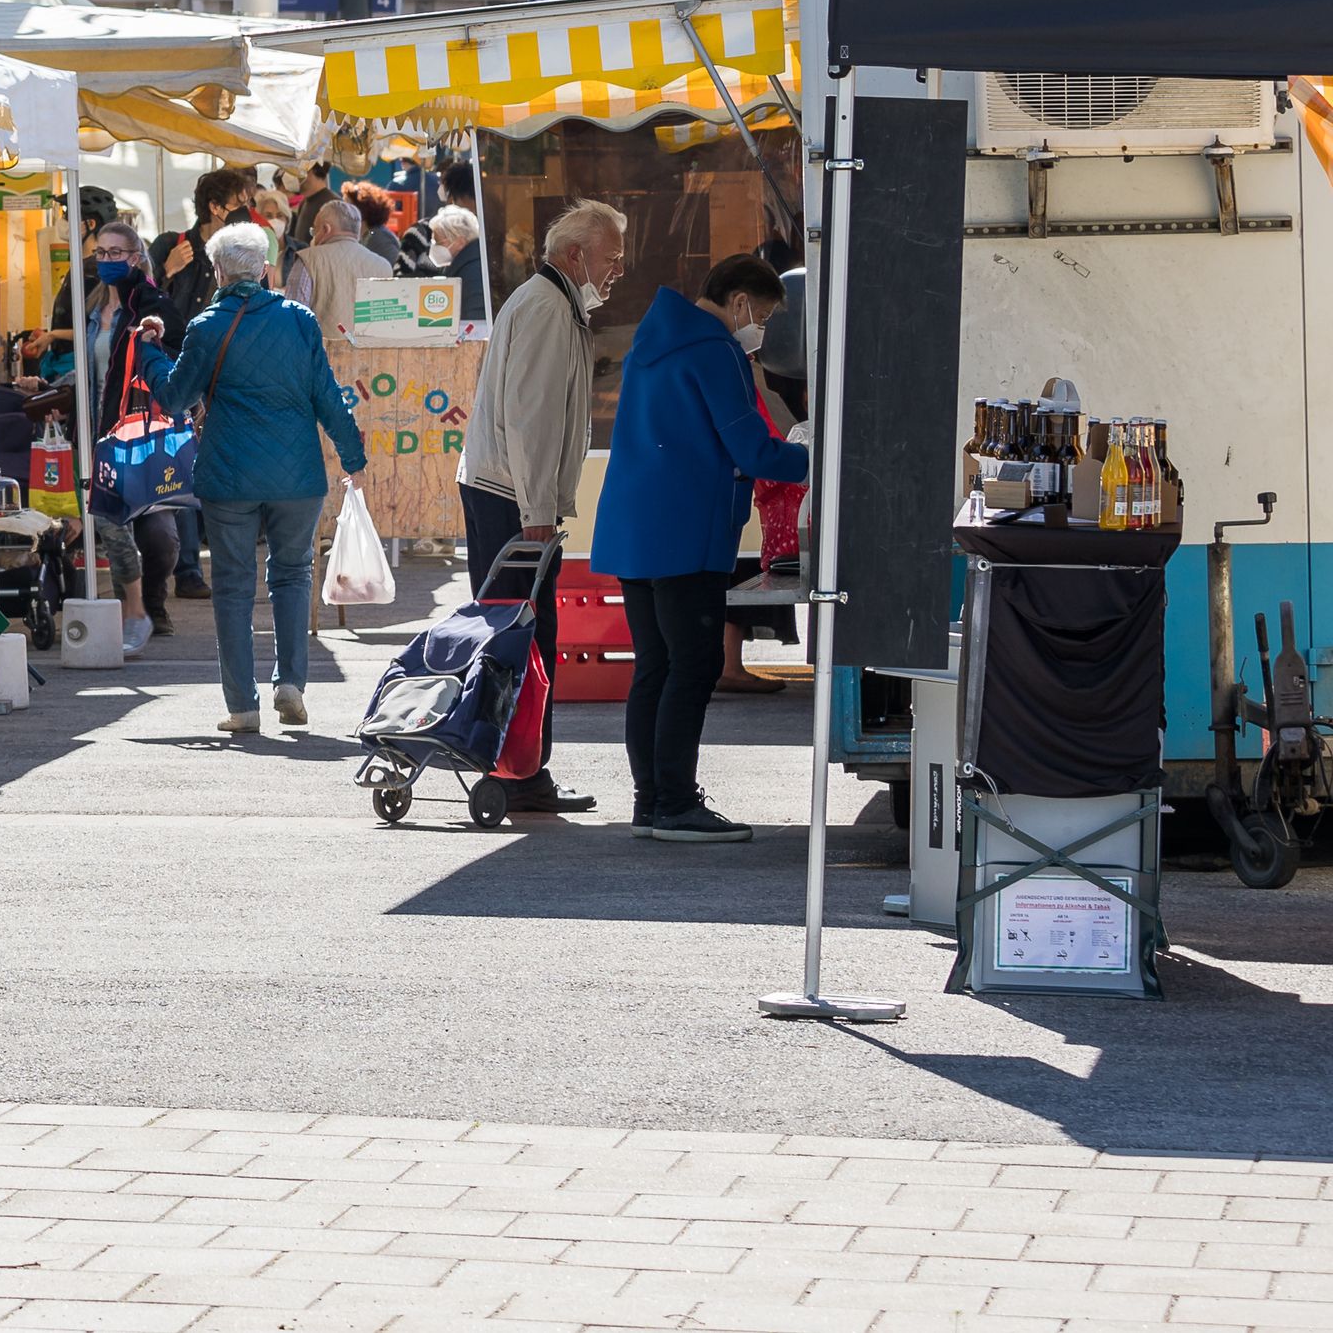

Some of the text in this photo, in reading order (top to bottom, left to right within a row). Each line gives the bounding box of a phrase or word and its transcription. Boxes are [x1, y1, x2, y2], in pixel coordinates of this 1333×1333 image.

[427, 294, 445, 305] Bio
[341, 373, 468, 426] BIO HOF
[155, 481, 184, 495] Tchibo
